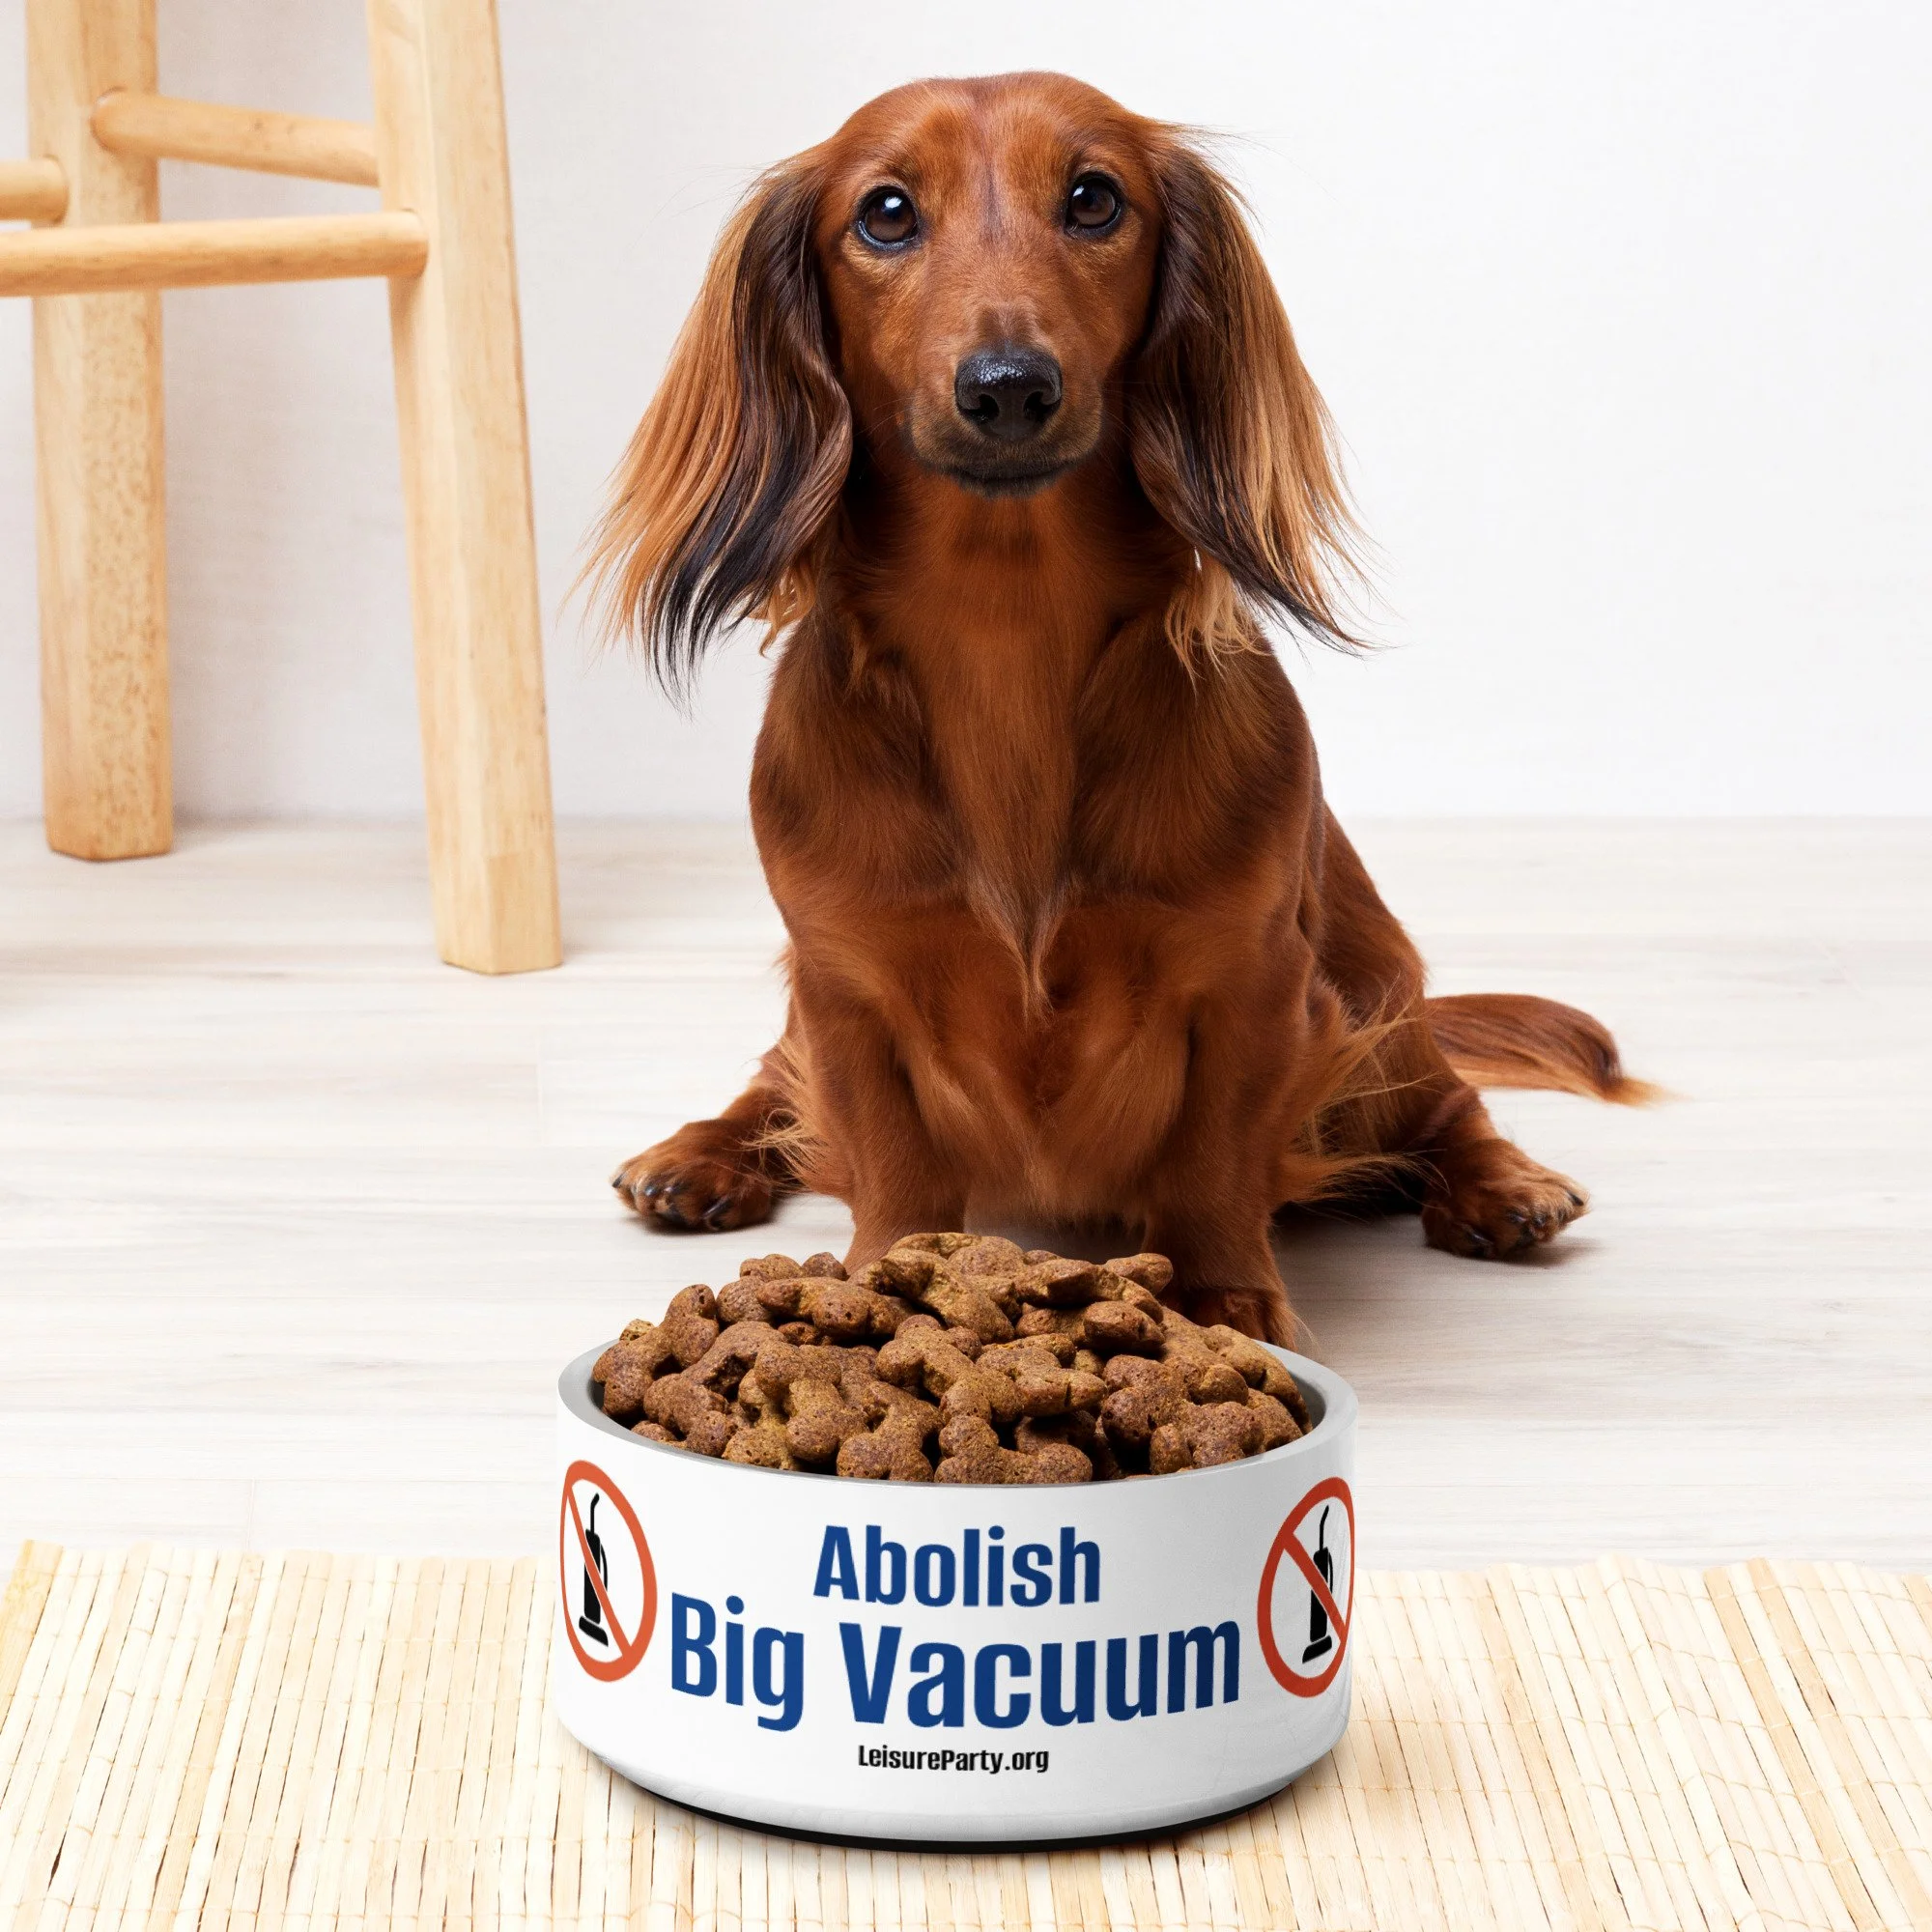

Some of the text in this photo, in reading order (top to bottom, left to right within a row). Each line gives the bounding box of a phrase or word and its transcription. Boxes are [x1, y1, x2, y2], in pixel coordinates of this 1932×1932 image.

[812, 1523, 1101, 1607] Abolish
[671, 1591, 1240, 1733] Big Vacuum
[858, 1745, 1049, 1775] LeisureParty.org
